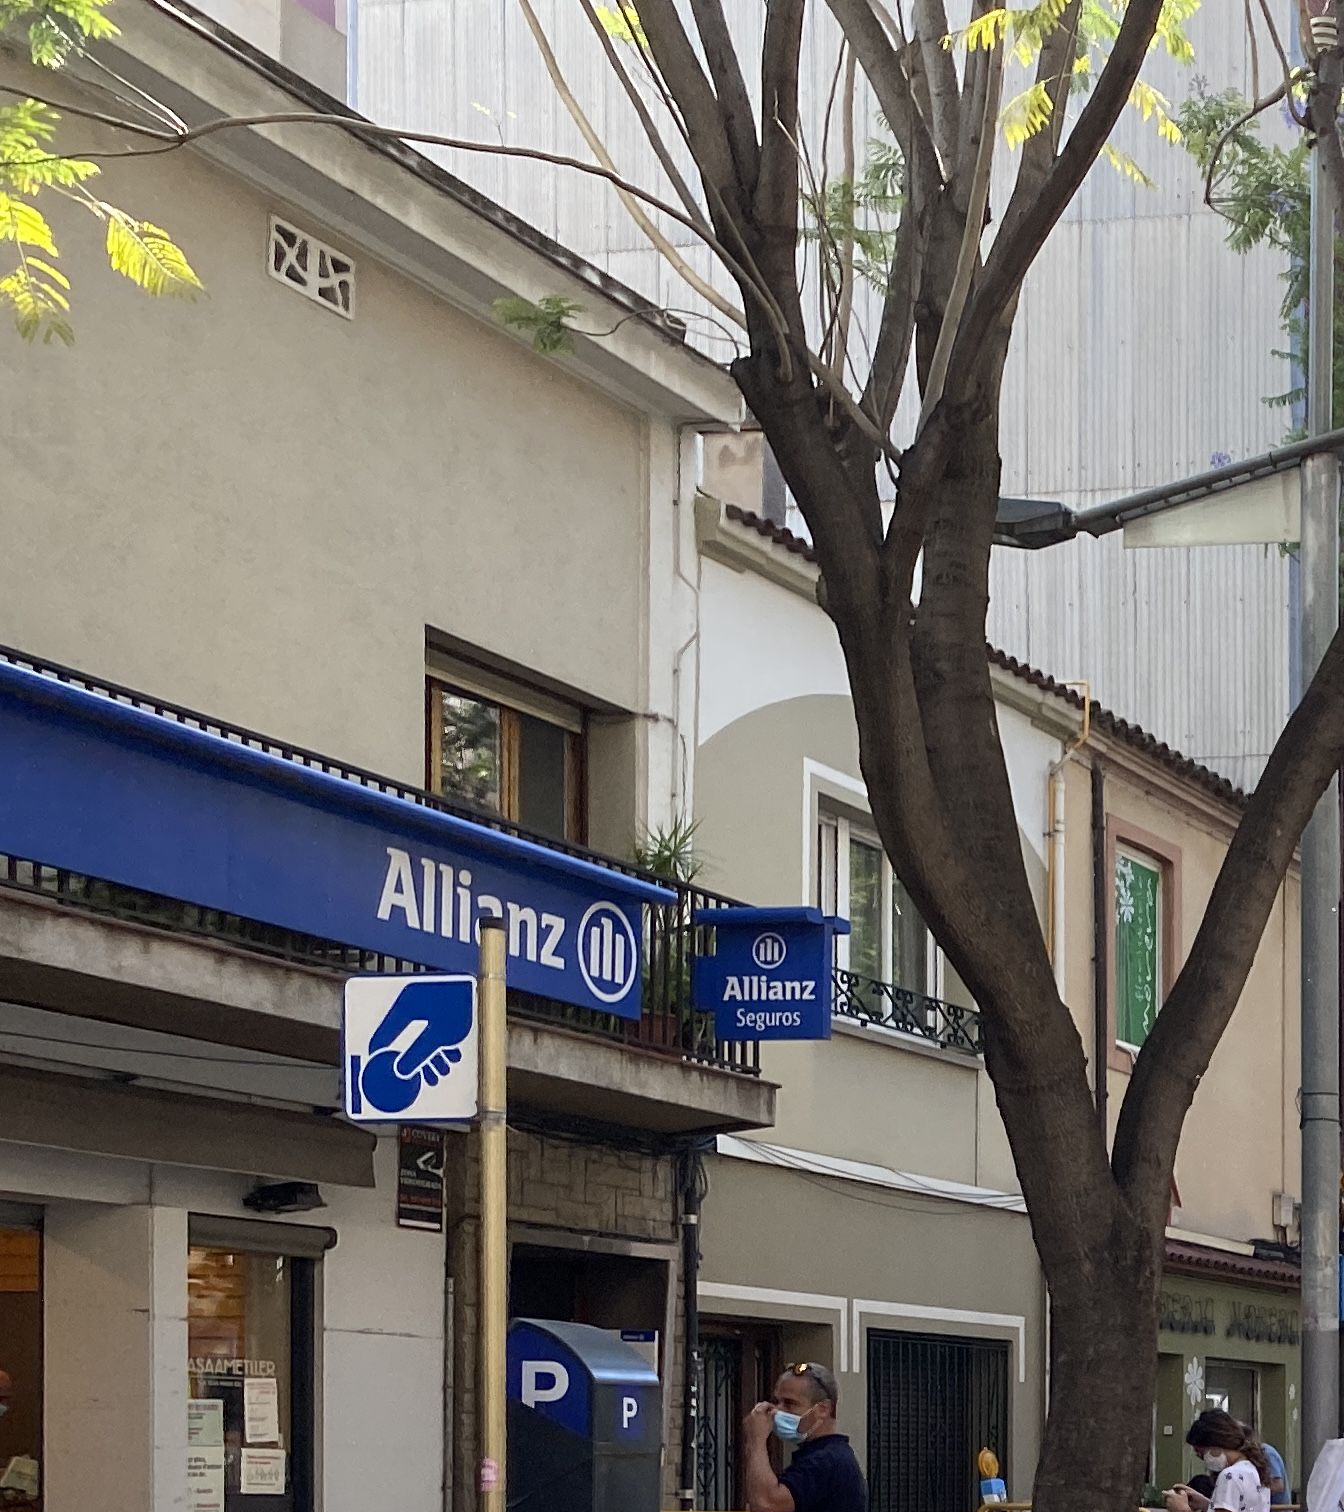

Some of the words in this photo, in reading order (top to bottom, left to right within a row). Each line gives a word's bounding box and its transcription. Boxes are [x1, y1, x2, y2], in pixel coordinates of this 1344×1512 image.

[723, 976, 816, 1001] Allianz
[735, 1008, 801, 1032] Seguros
[522, 1360, 569, 1409] P
[622, 1397, 638, 1429] P
